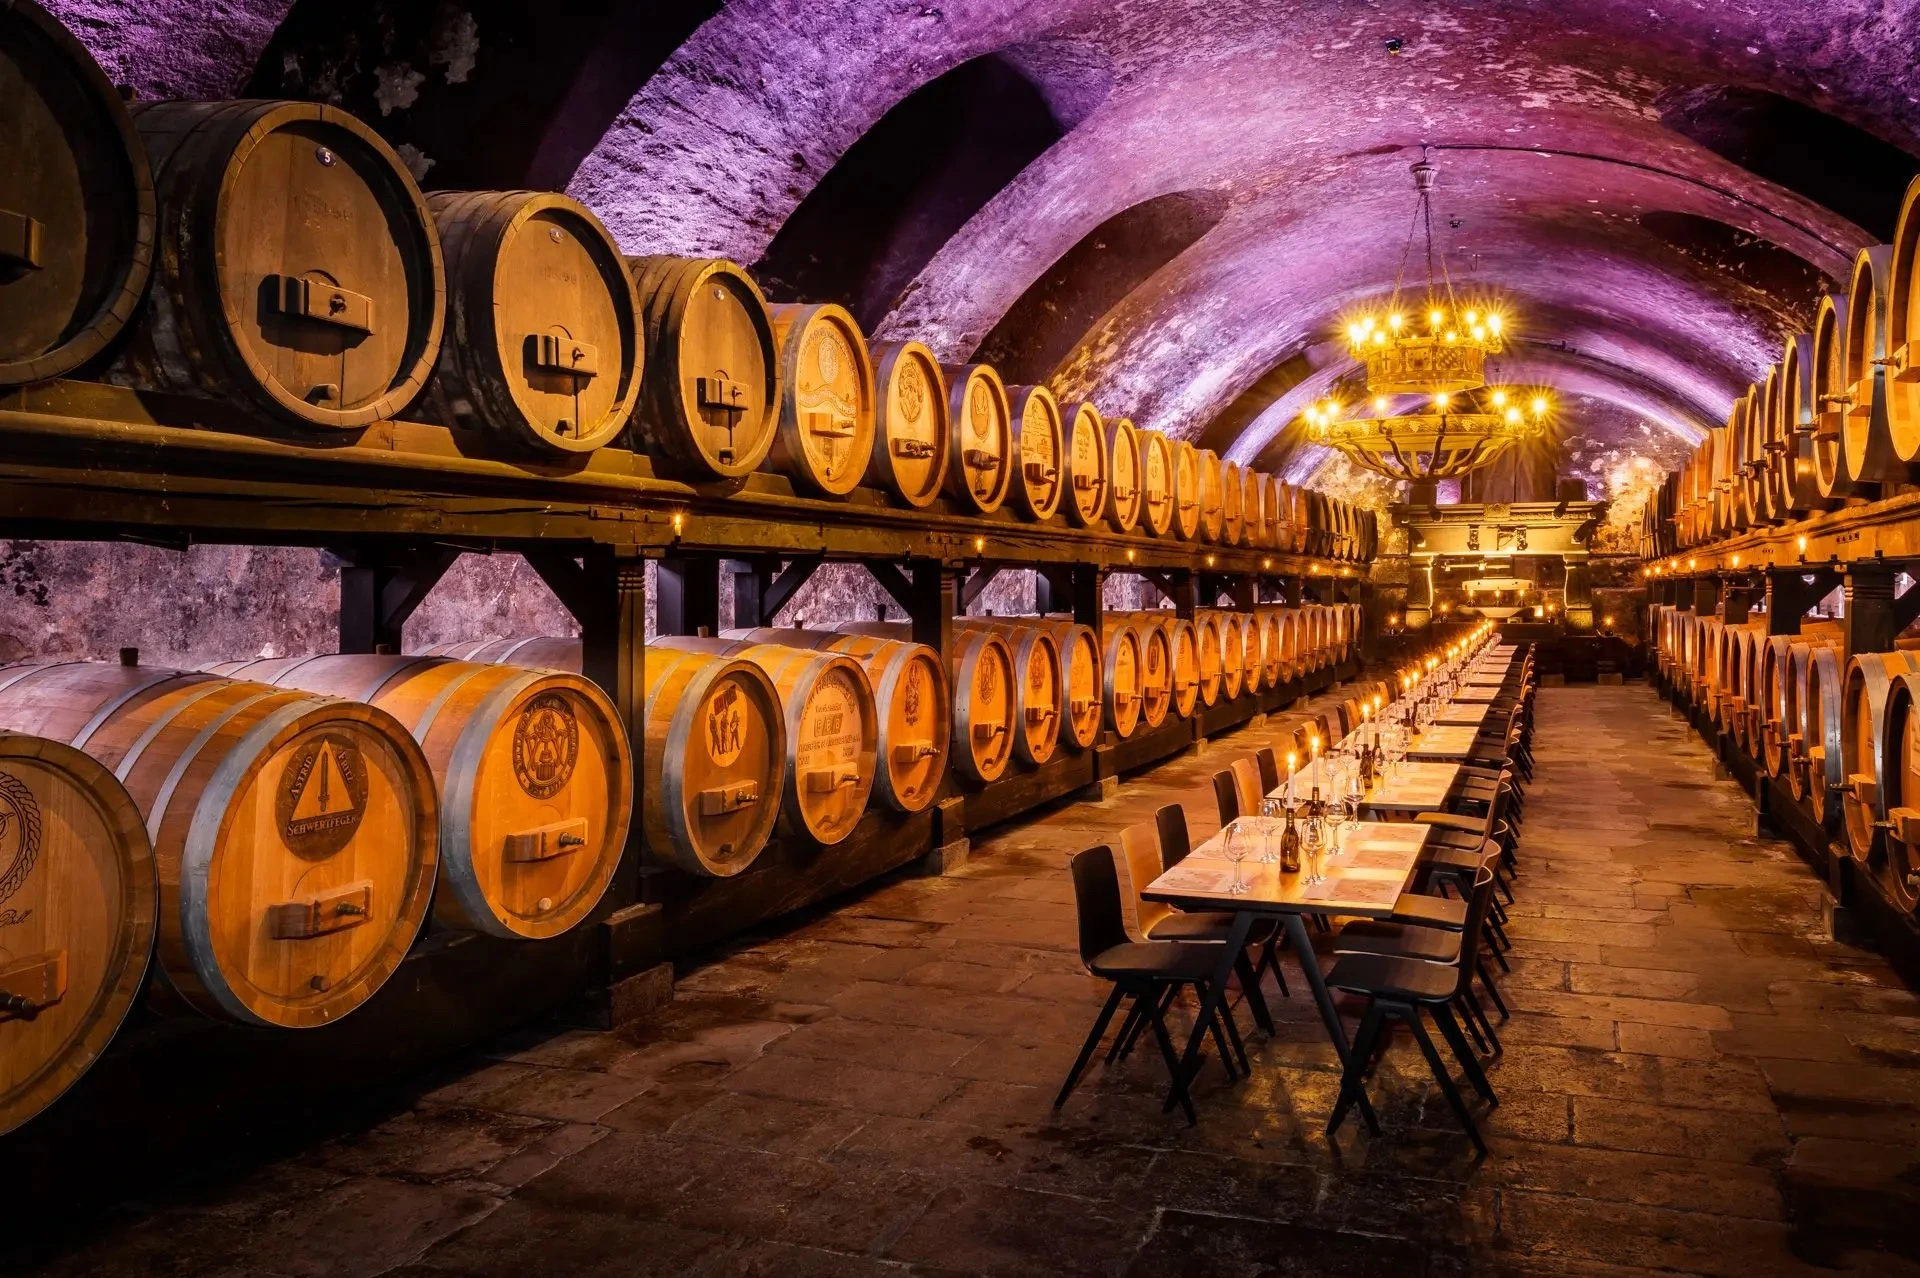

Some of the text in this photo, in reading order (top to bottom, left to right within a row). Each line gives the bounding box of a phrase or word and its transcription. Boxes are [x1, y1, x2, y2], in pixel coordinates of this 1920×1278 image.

[324, 151, 331, 163] 5
[291, 755, 313, 797] ASTRID
[287, 814, 357, 836] SCHWERTFEGER
